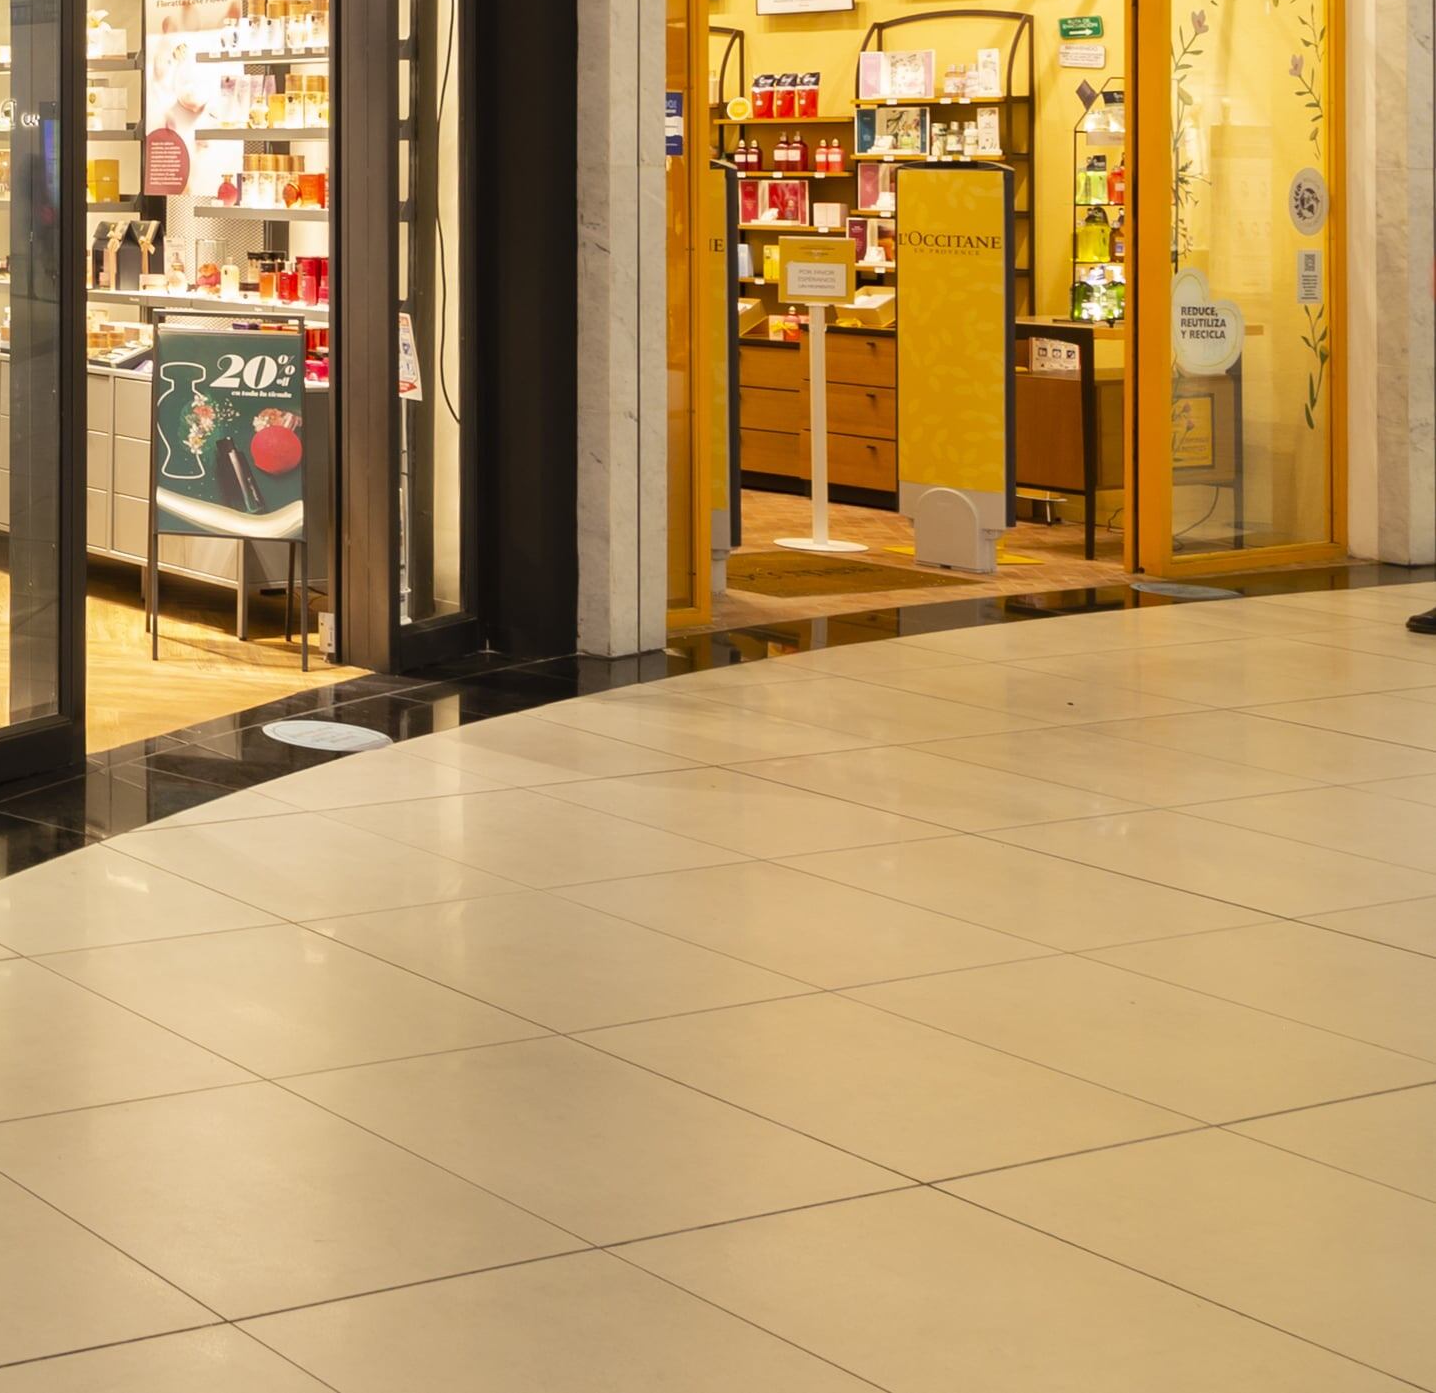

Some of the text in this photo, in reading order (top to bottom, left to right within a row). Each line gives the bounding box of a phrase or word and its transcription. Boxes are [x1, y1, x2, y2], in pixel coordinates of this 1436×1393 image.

[898, 230, 1002, 249] L'OCCITANE
[1180, 306, 1218, 317] REDUCE,
[1180, 318, 1226, 328] REUTILIZA
[1180, 330, 1226, 339] Y RECICLA
[209, 353, 296, 390] 20%
